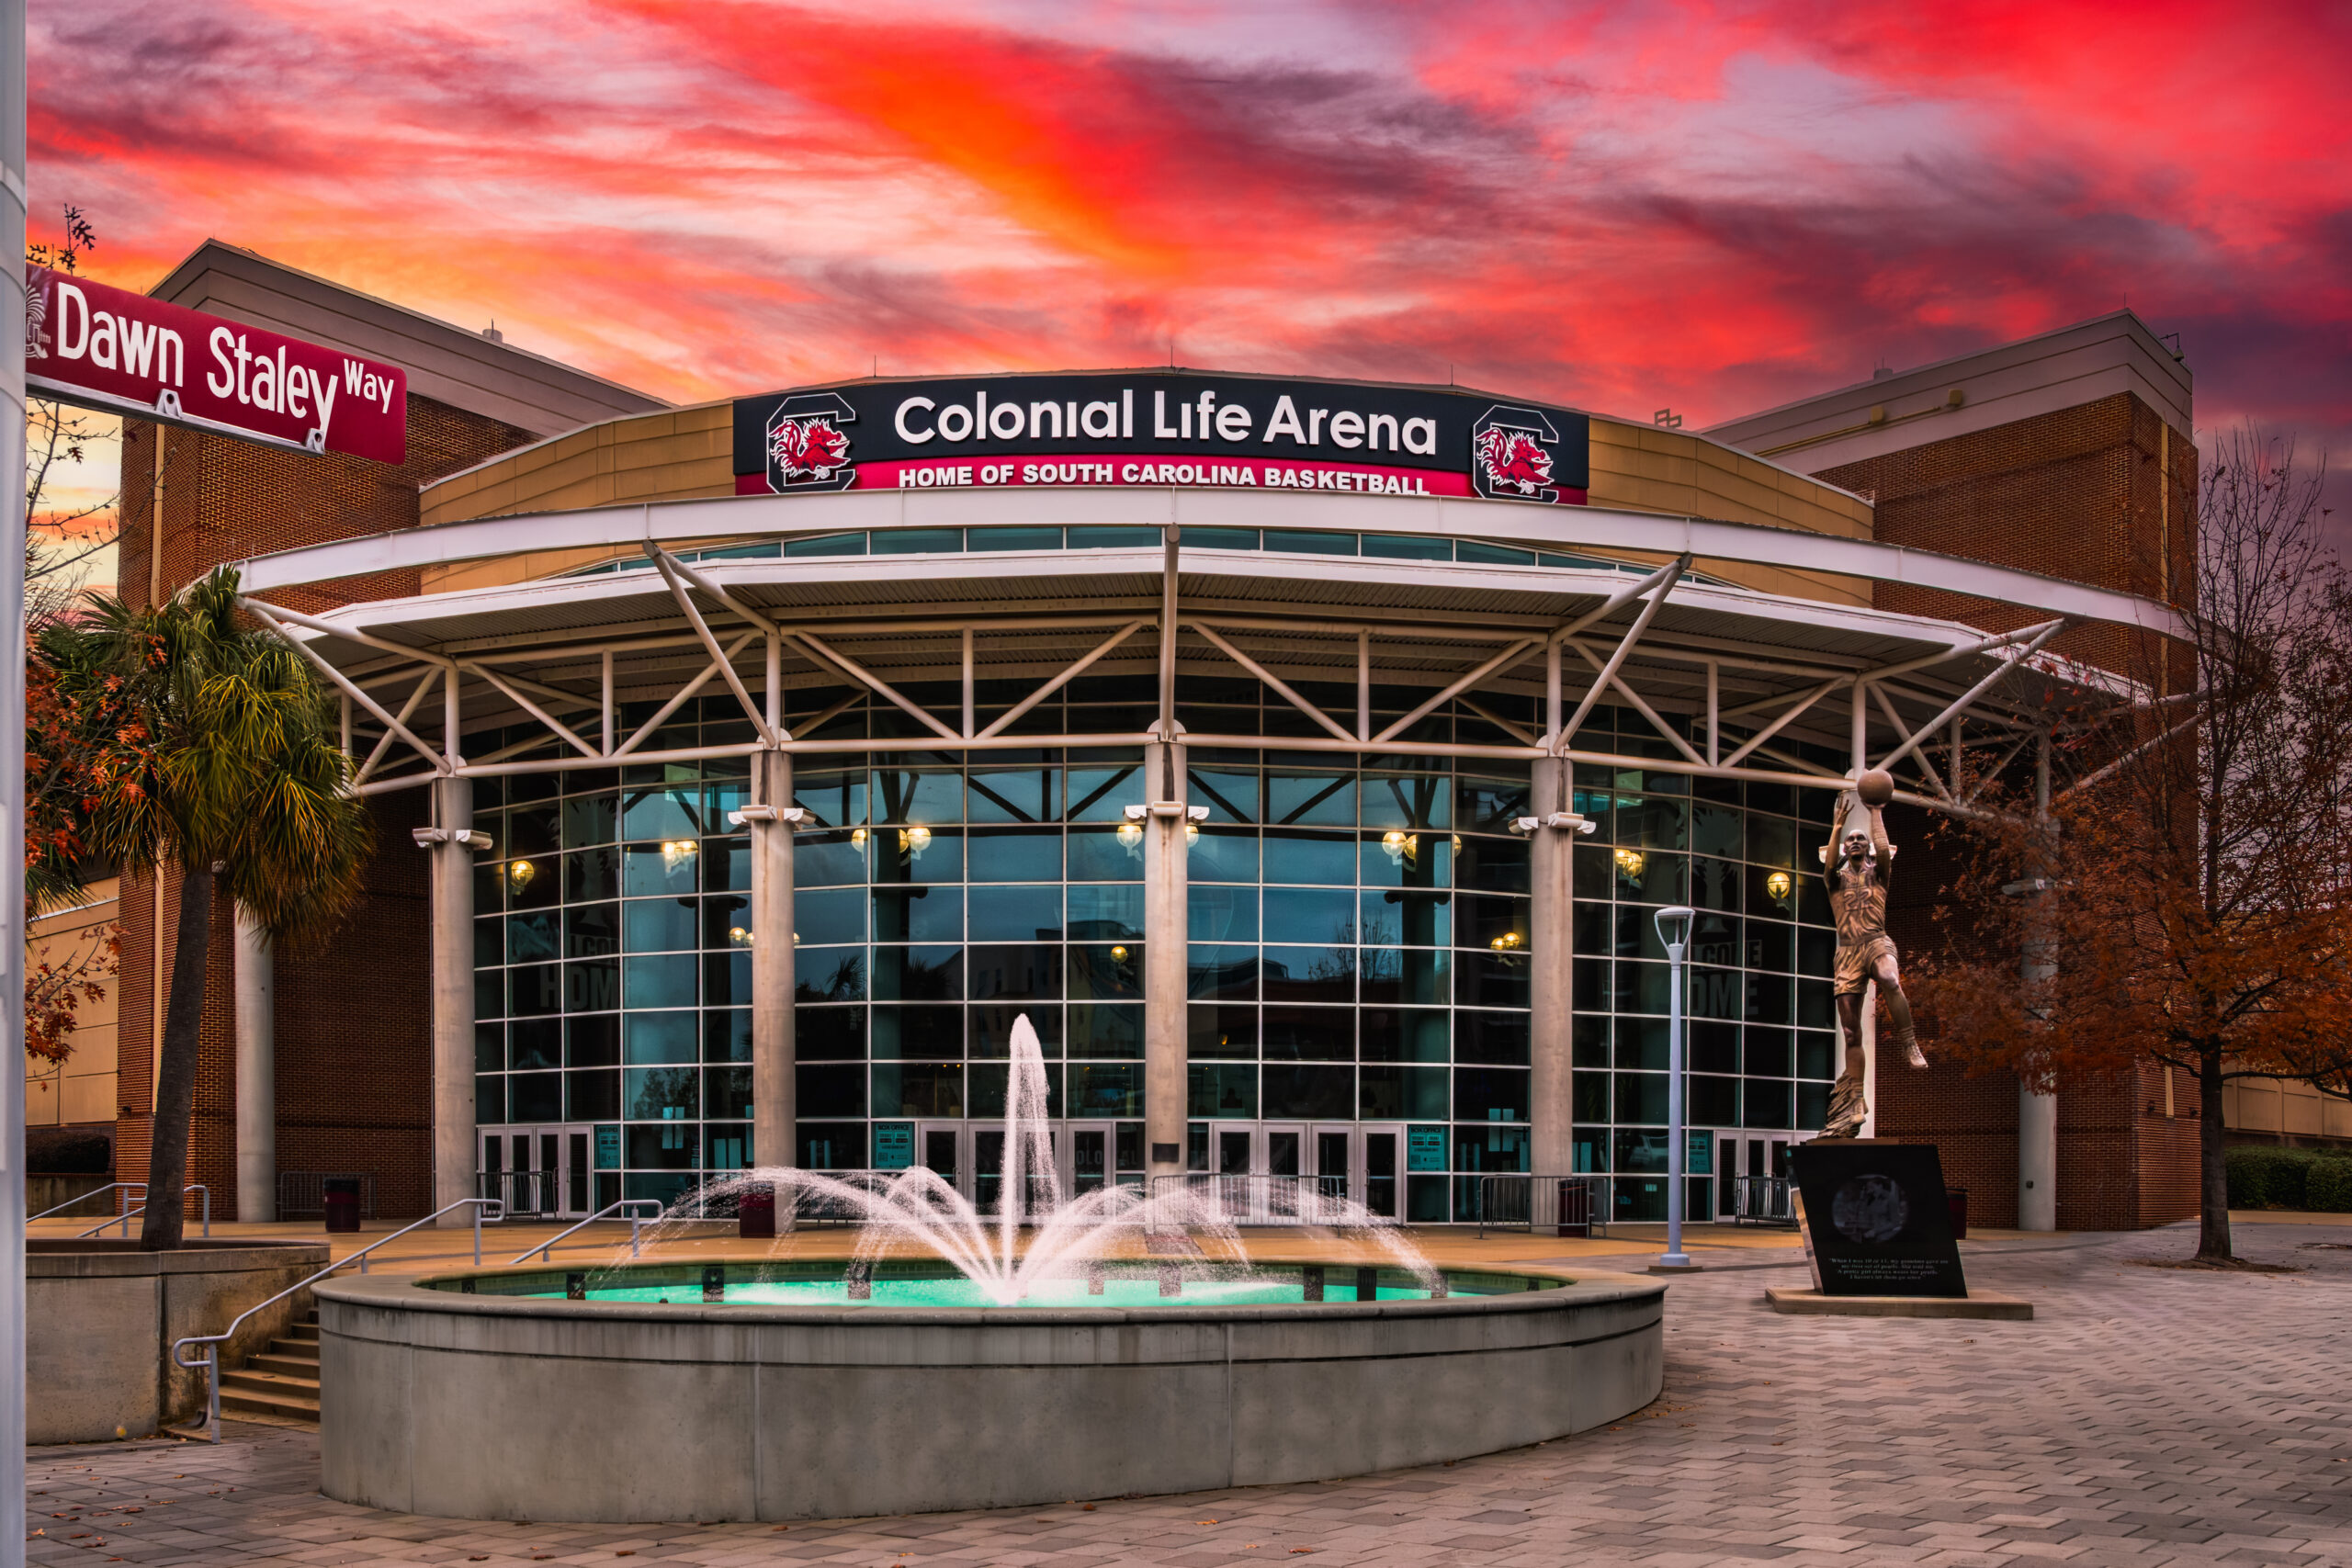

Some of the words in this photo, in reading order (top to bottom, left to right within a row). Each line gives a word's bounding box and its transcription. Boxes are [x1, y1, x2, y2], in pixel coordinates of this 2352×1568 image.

[58, 282, 184, 388] Dawn
[207, 326, 338, 434] Staley
[344, 358, 394, 414] Way
[894, 389, 1133, 445] Colonial
[1153, 389, 1252, 441] Life
[1262, 394, 1436, 456] Arena
[899, 468, 973, 488] HOME
[980, 465, 1014, 484] OF
[1023, 464, 1113, 484] SOUTH
[1121, 463, 1256, 486] CAROLINA
[1264, 468, 1430, 495] BASKETBALL
